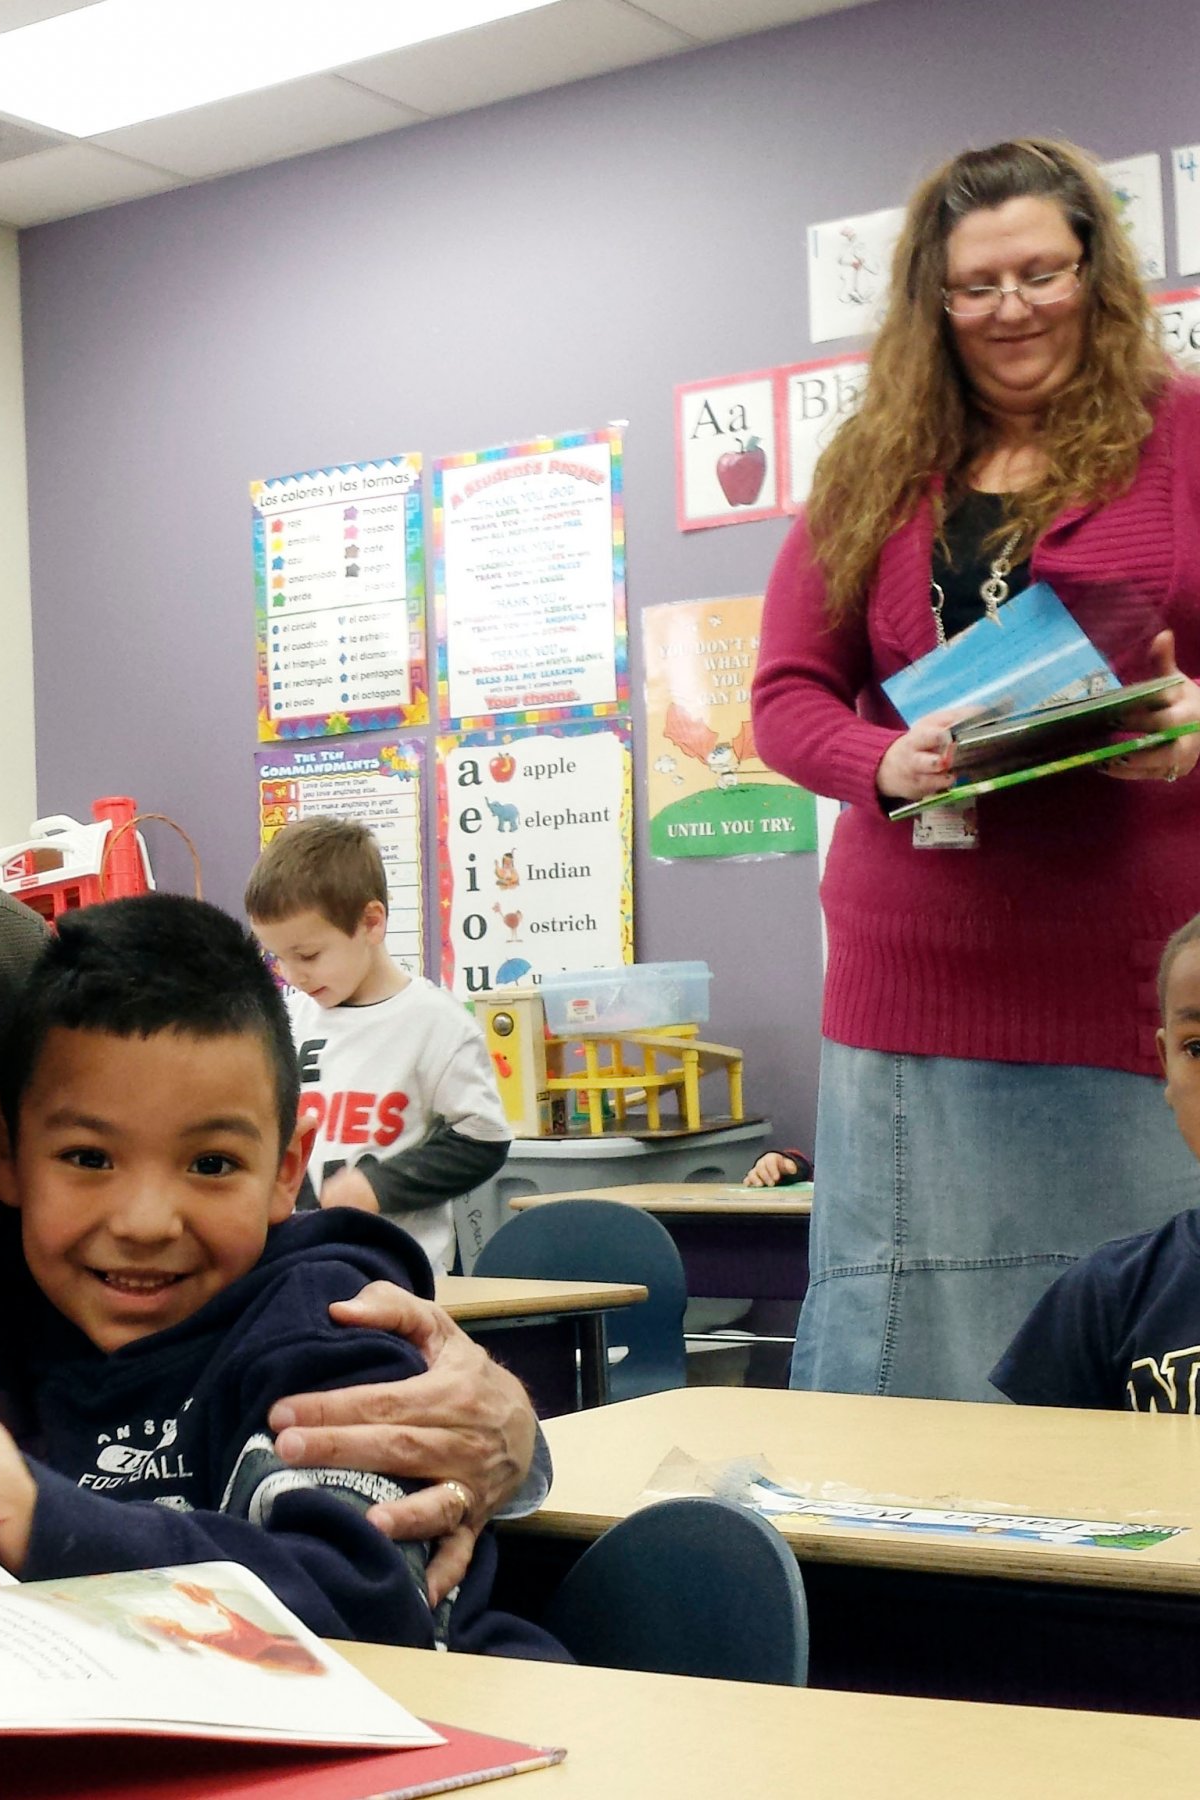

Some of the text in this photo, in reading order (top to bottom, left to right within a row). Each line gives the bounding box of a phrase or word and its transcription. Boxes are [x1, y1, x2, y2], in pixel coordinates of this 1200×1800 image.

[1178, 152, 1199, 183] 4
[690, 399, 748, 440] Aa
[260, 472, 411, 508] Los colores y las formas
[288, 592, 313, 603] verde
[696, 637, 744, 656] DON'T
[704, 653, 750, 672] WHAT
[713, 671, 744, 688] YOU
[260, 758, 380, 778] COMMANDMENTS
[294, 750, 344, 764] THE TEN
[458, 757, 576, 787] a apple
[289, 784, 297, 800] 1
[287, 806, 299, 822] 2
[459, 807, 611, 834] e elephant
[667, 816, 796, 838] UNTIL YOU TRY.
[465, 853, 591, 892] i Indian
[462, 914, 597, 941] o ostrich
[463, 966, 493, 992] u
